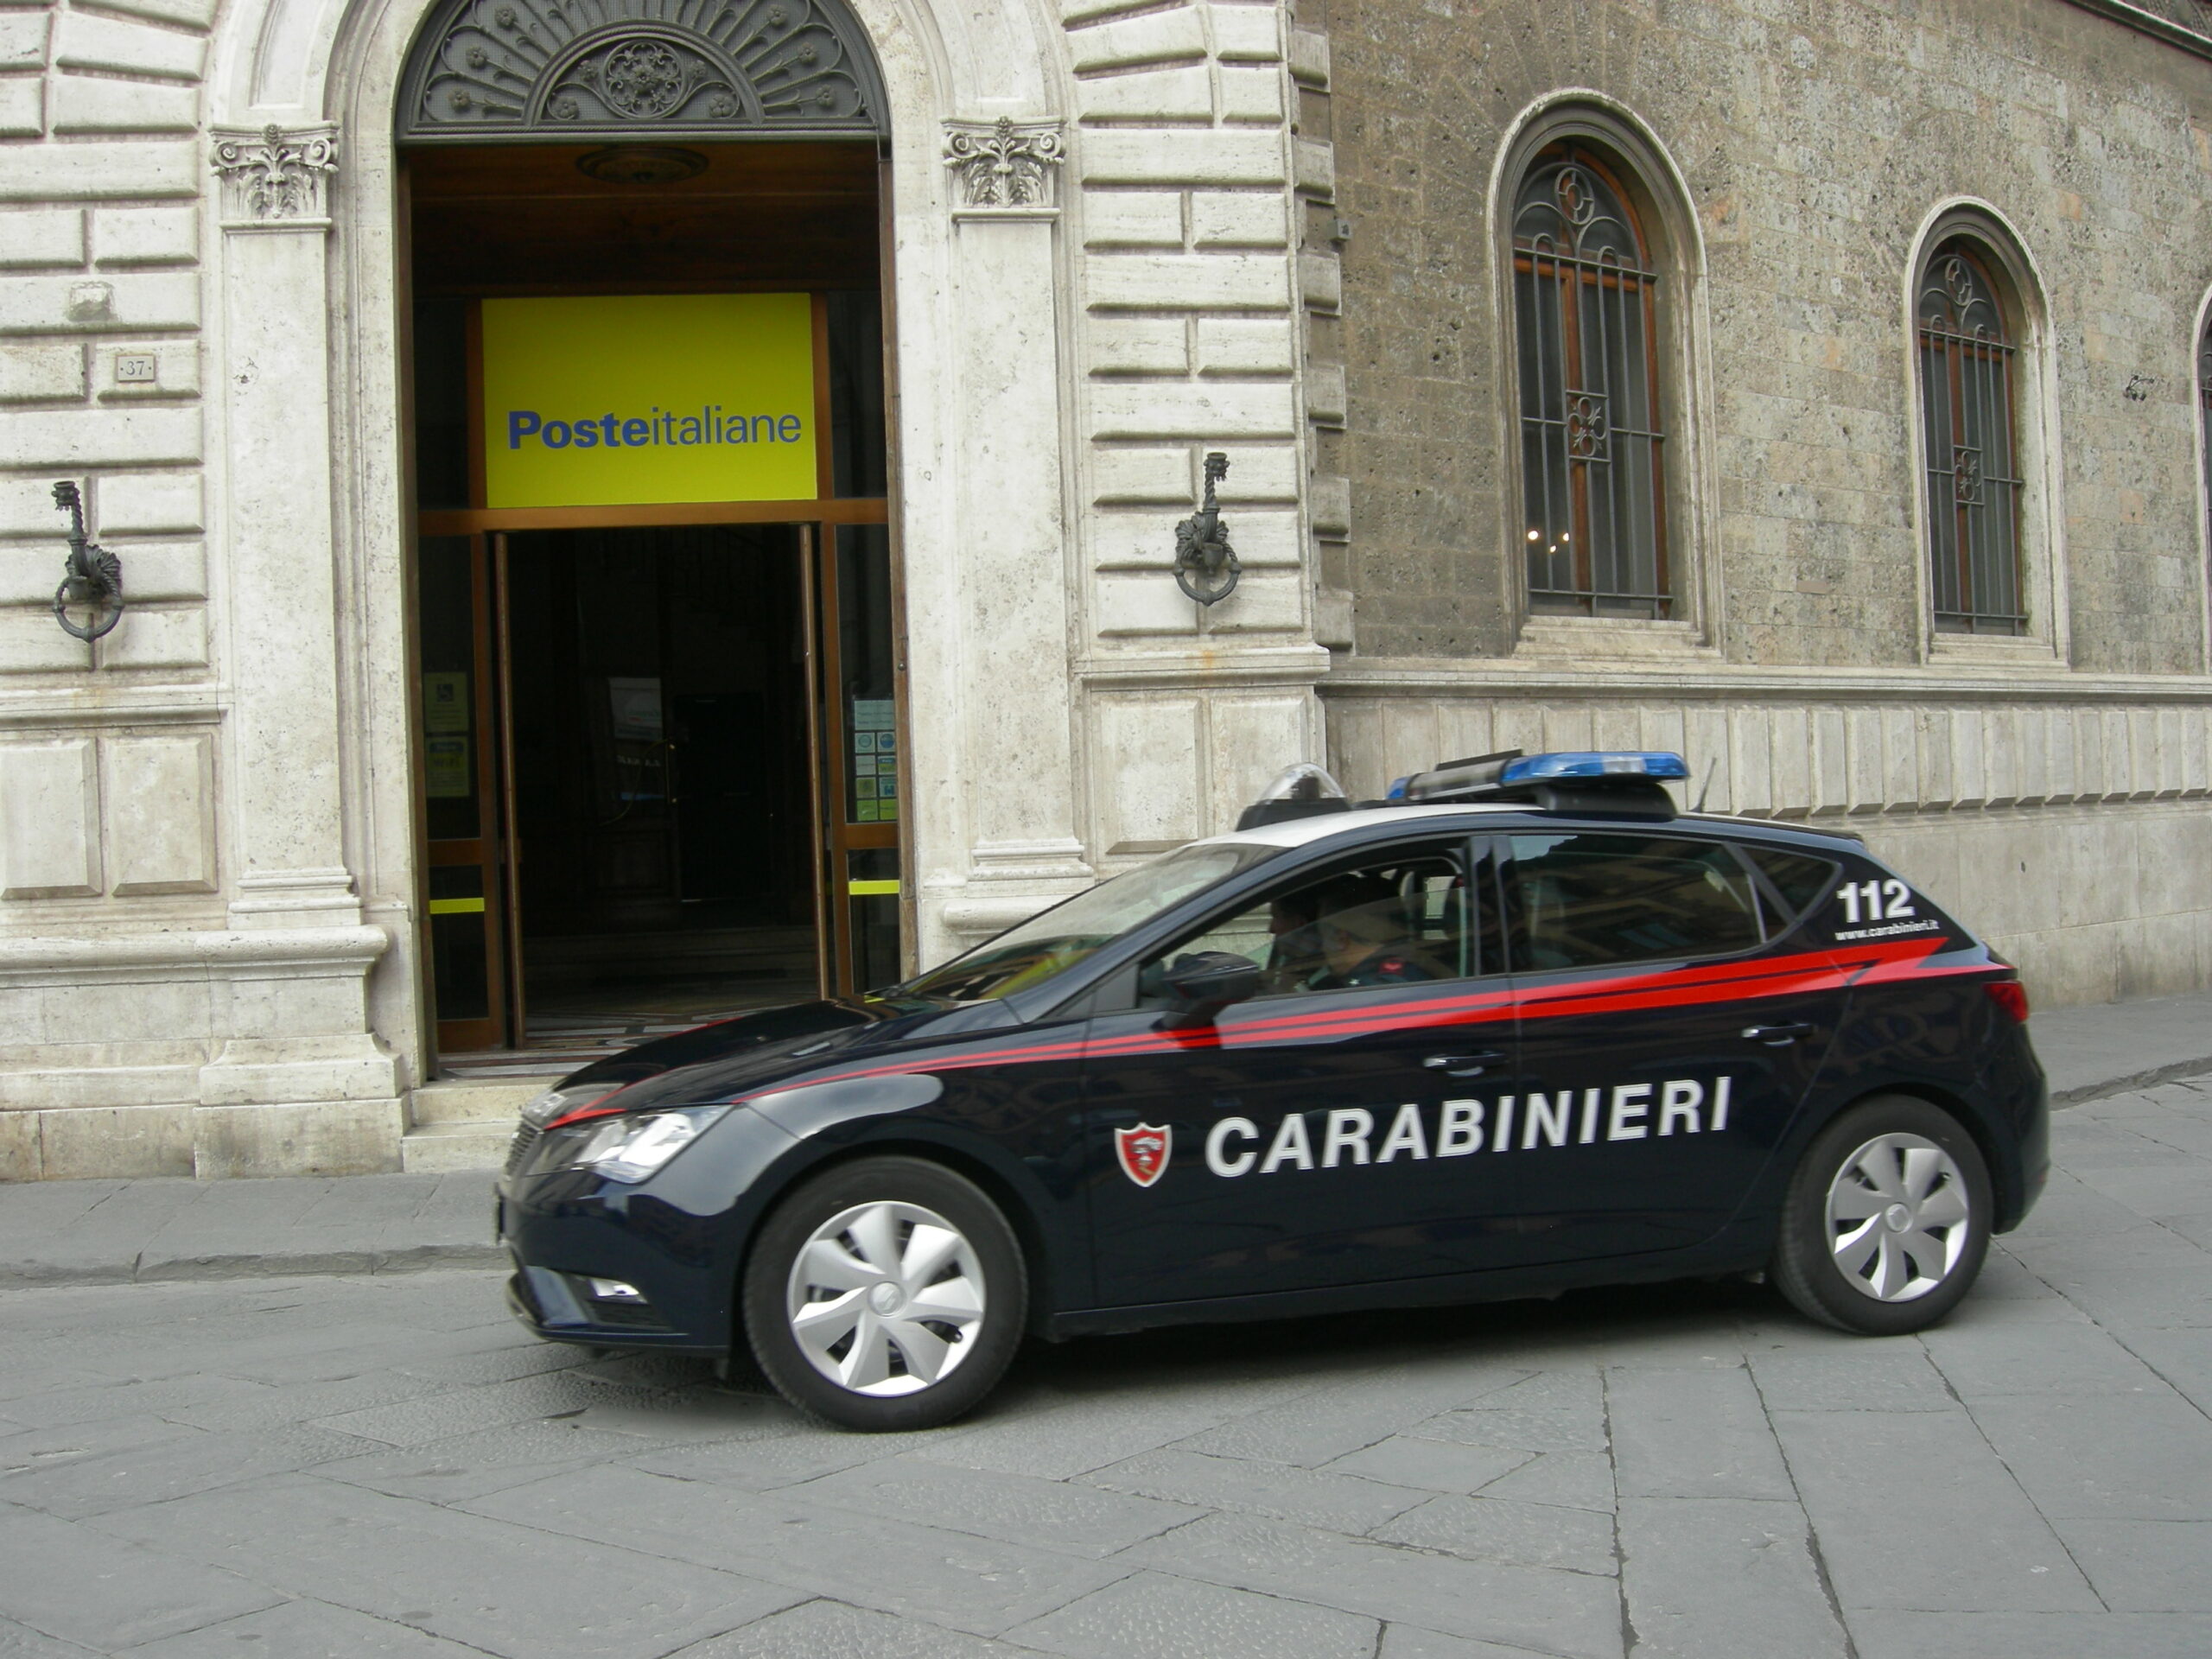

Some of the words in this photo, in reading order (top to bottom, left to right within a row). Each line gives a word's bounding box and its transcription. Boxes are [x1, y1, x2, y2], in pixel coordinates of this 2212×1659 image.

[125, 360, 145, 376] 37
[1837, 878, 1915, 923] 112
[1835, 919, 1940, 940] www.carabinieri.it
[1205, 1076, 1731, 1178] CARABINIERI
